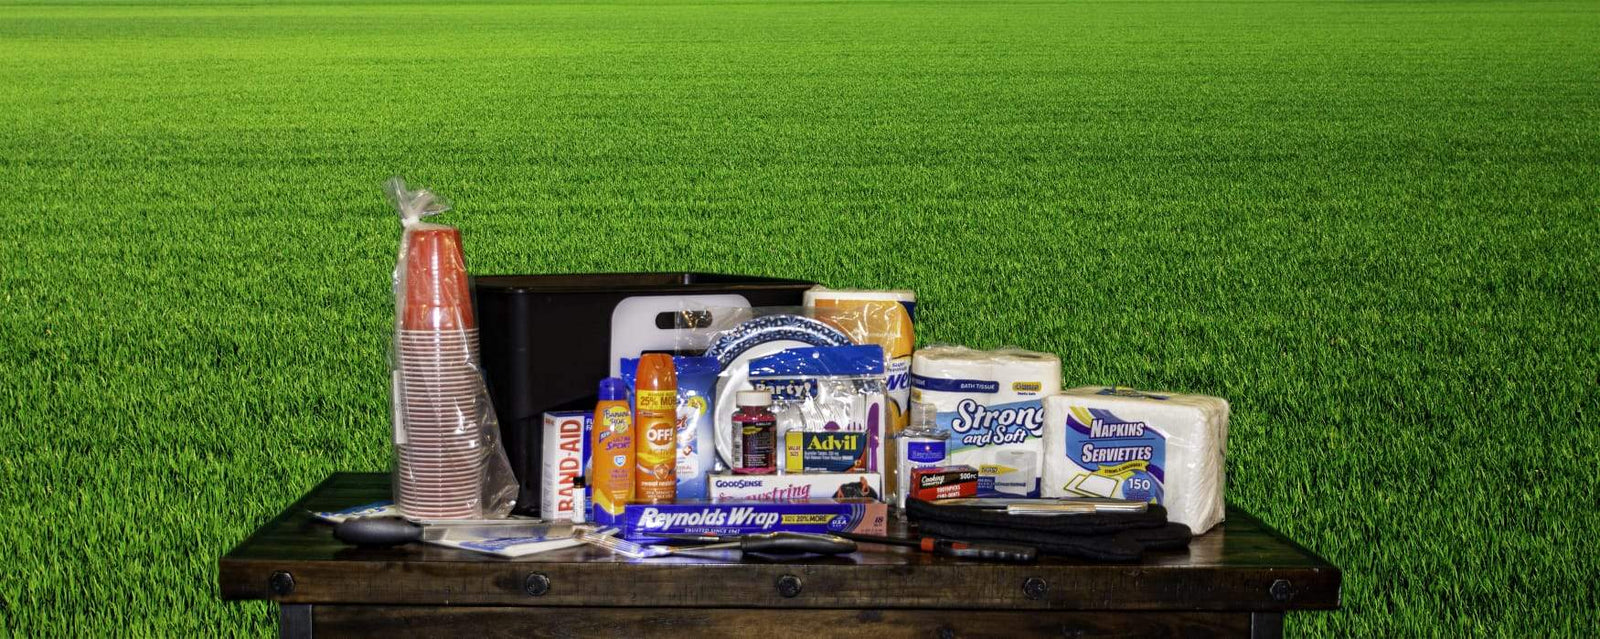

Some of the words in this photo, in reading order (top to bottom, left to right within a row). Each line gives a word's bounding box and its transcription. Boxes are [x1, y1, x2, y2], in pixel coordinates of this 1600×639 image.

[640, 396, 658, 405] 25%
[646, 428, 673, 441] OFF!
[963, 429, 992, 447] and
[993, 424, 1027, 445] Soft
[1091, 418, 1146, 438] NAPKINS
[807, 434, 857, 451] Advil
[1081, 444, 1153, 463] SERVIETTES
[558, 419, 582, 511] BAND-AID
[1128, 479, 1151, 490] 150
[636, 507, 727, 531] Reynolds
[727, 507, 779, 529] Wrap
